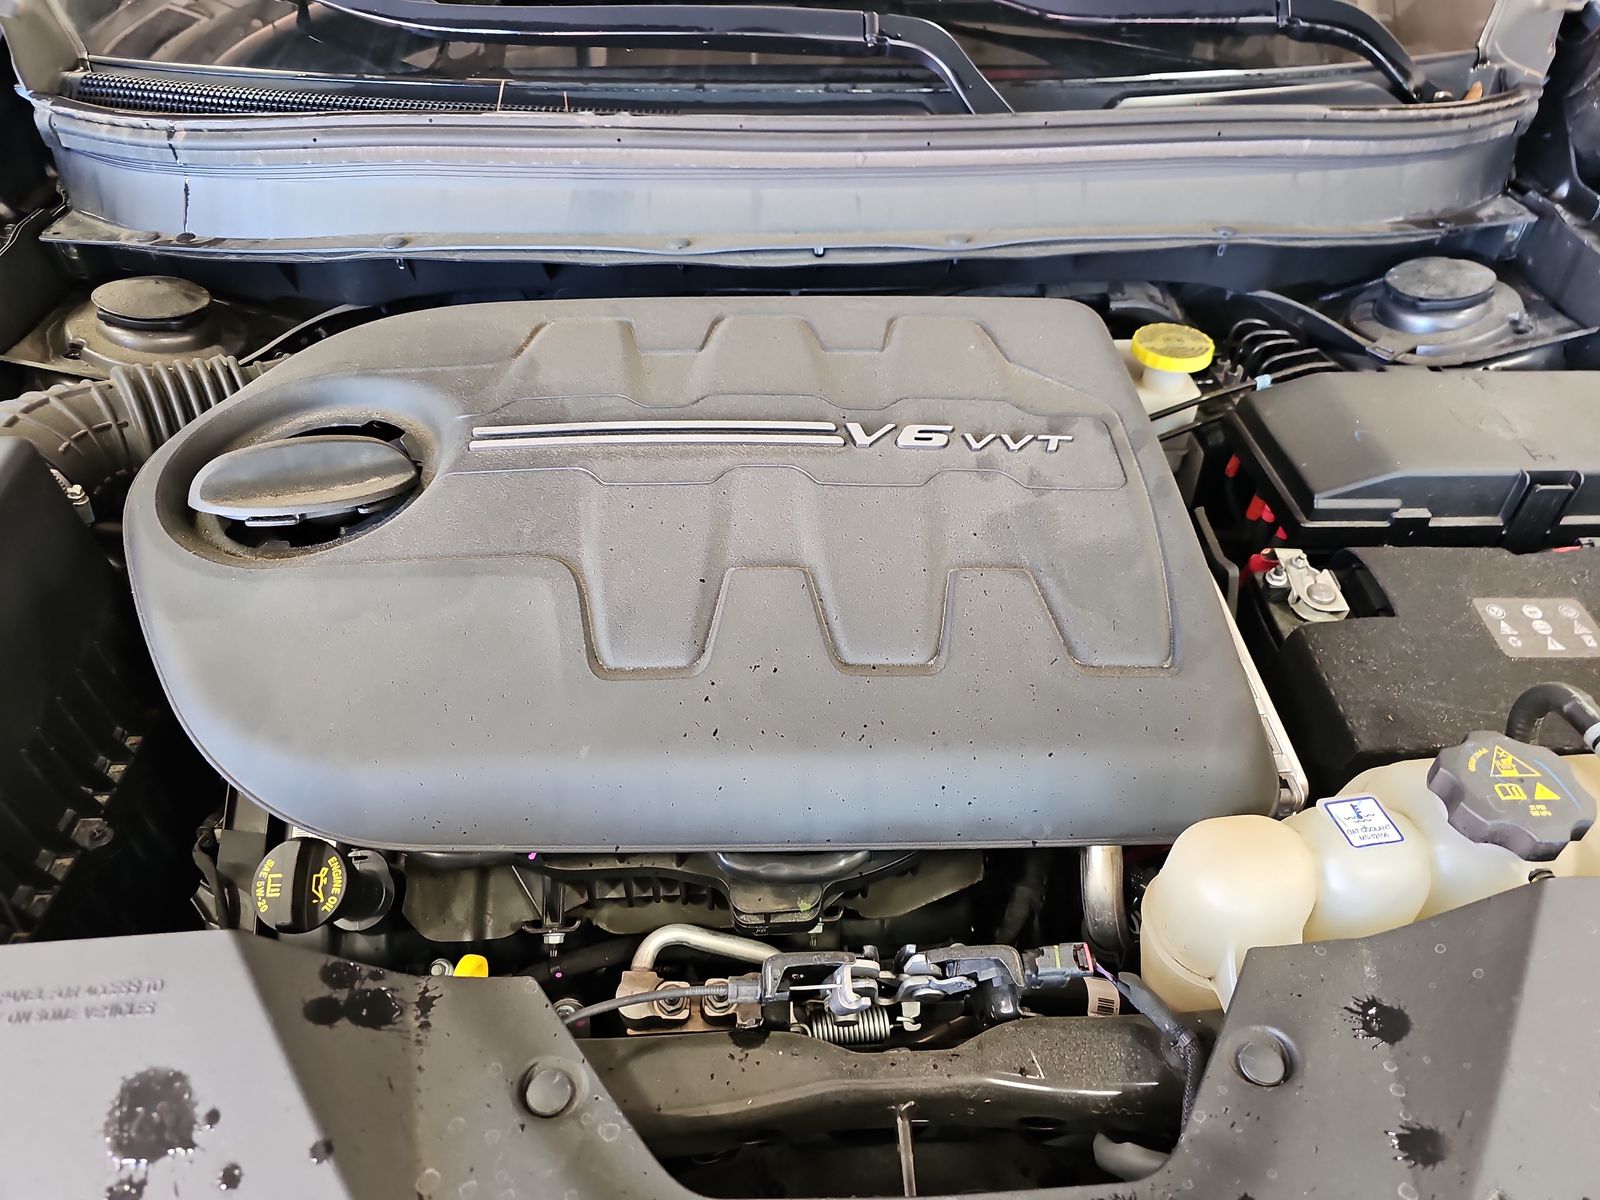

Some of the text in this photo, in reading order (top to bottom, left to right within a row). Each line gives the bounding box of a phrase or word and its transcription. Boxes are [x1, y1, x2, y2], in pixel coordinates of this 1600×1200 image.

[845, 422, 1074, 453] V6 VVT
[1360, 824, 1391, 833] COOLANT
[255, 859, 275, 913] SAE 5W-20
[321, 856, 343, 912] ENGINE OIL
[85, 1001, 157, 1019] VEHICLES
